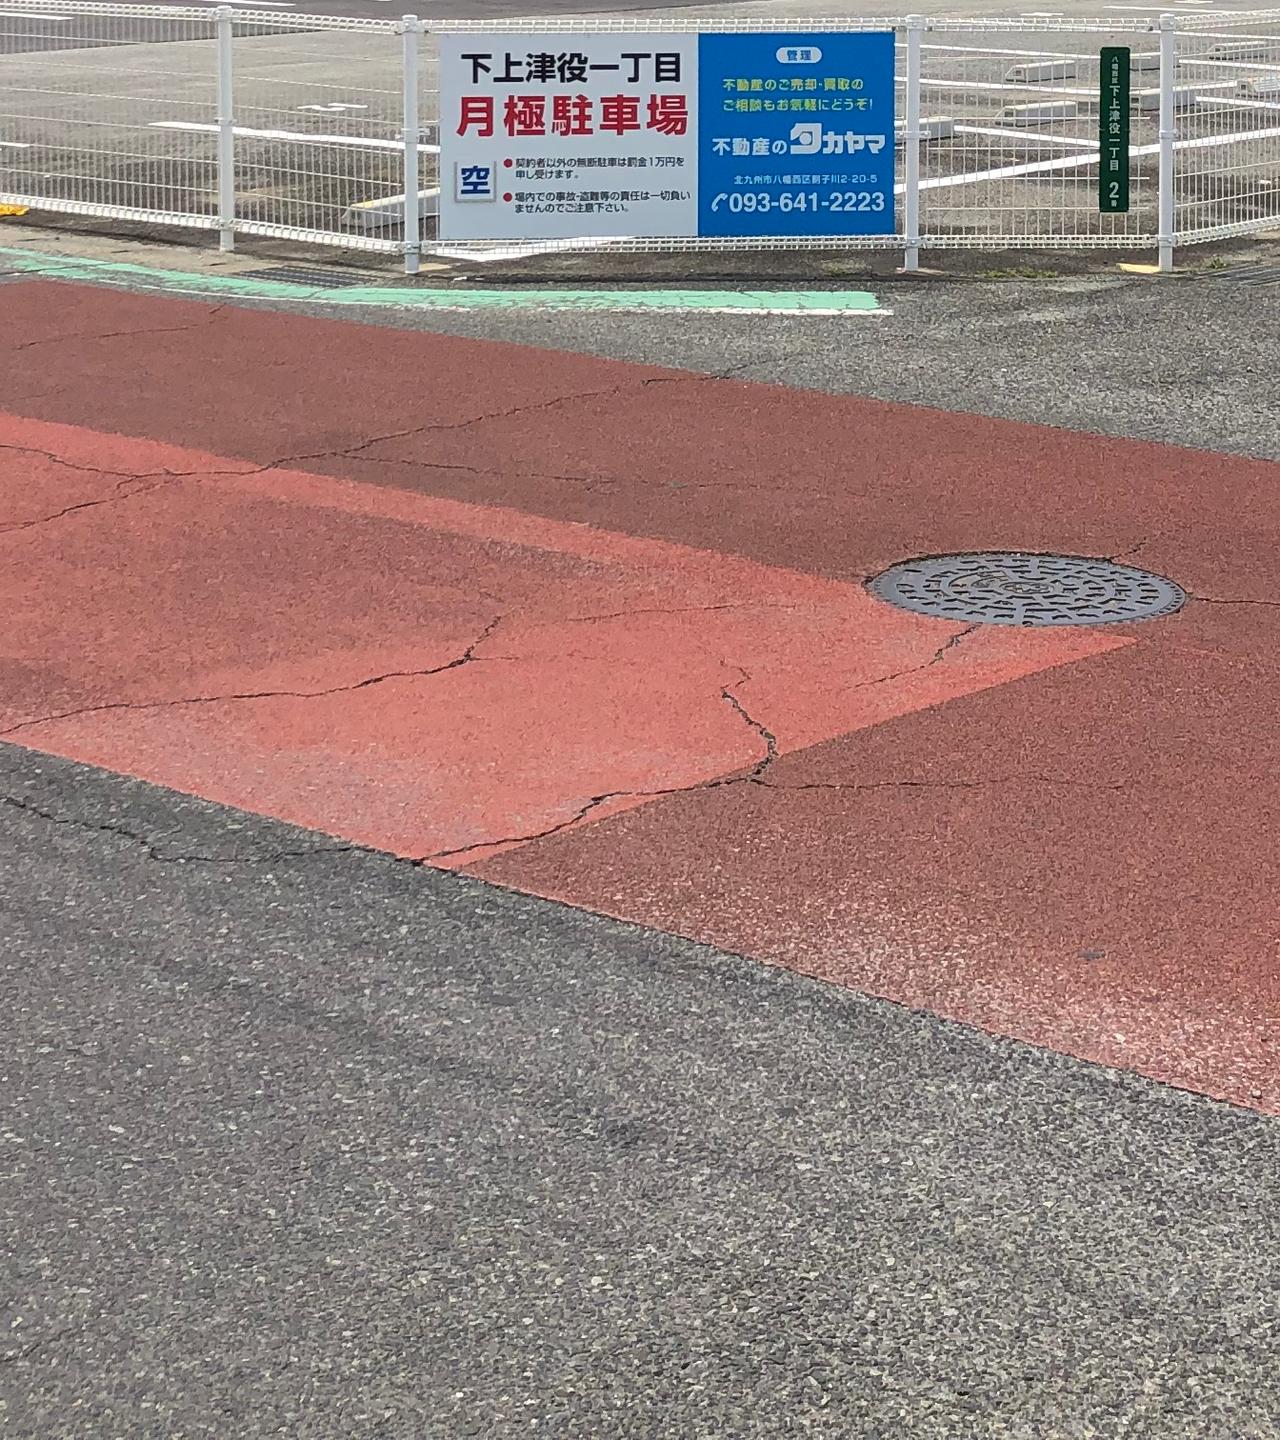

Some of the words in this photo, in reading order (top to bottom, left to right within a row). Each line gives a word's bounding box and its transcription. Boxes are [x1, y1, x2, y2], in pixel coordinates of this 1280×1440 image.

[786, 50, 812, 61] 管理
[461, 53, 681, 83] 下上津役一丁目
[456, 94, 688, 137] 月極駐車場
[461, 165, 490, 194] 空
[515, 169, 579, 180] 申し受けます。
[729, 192, 885, 212] 093-641-2223
